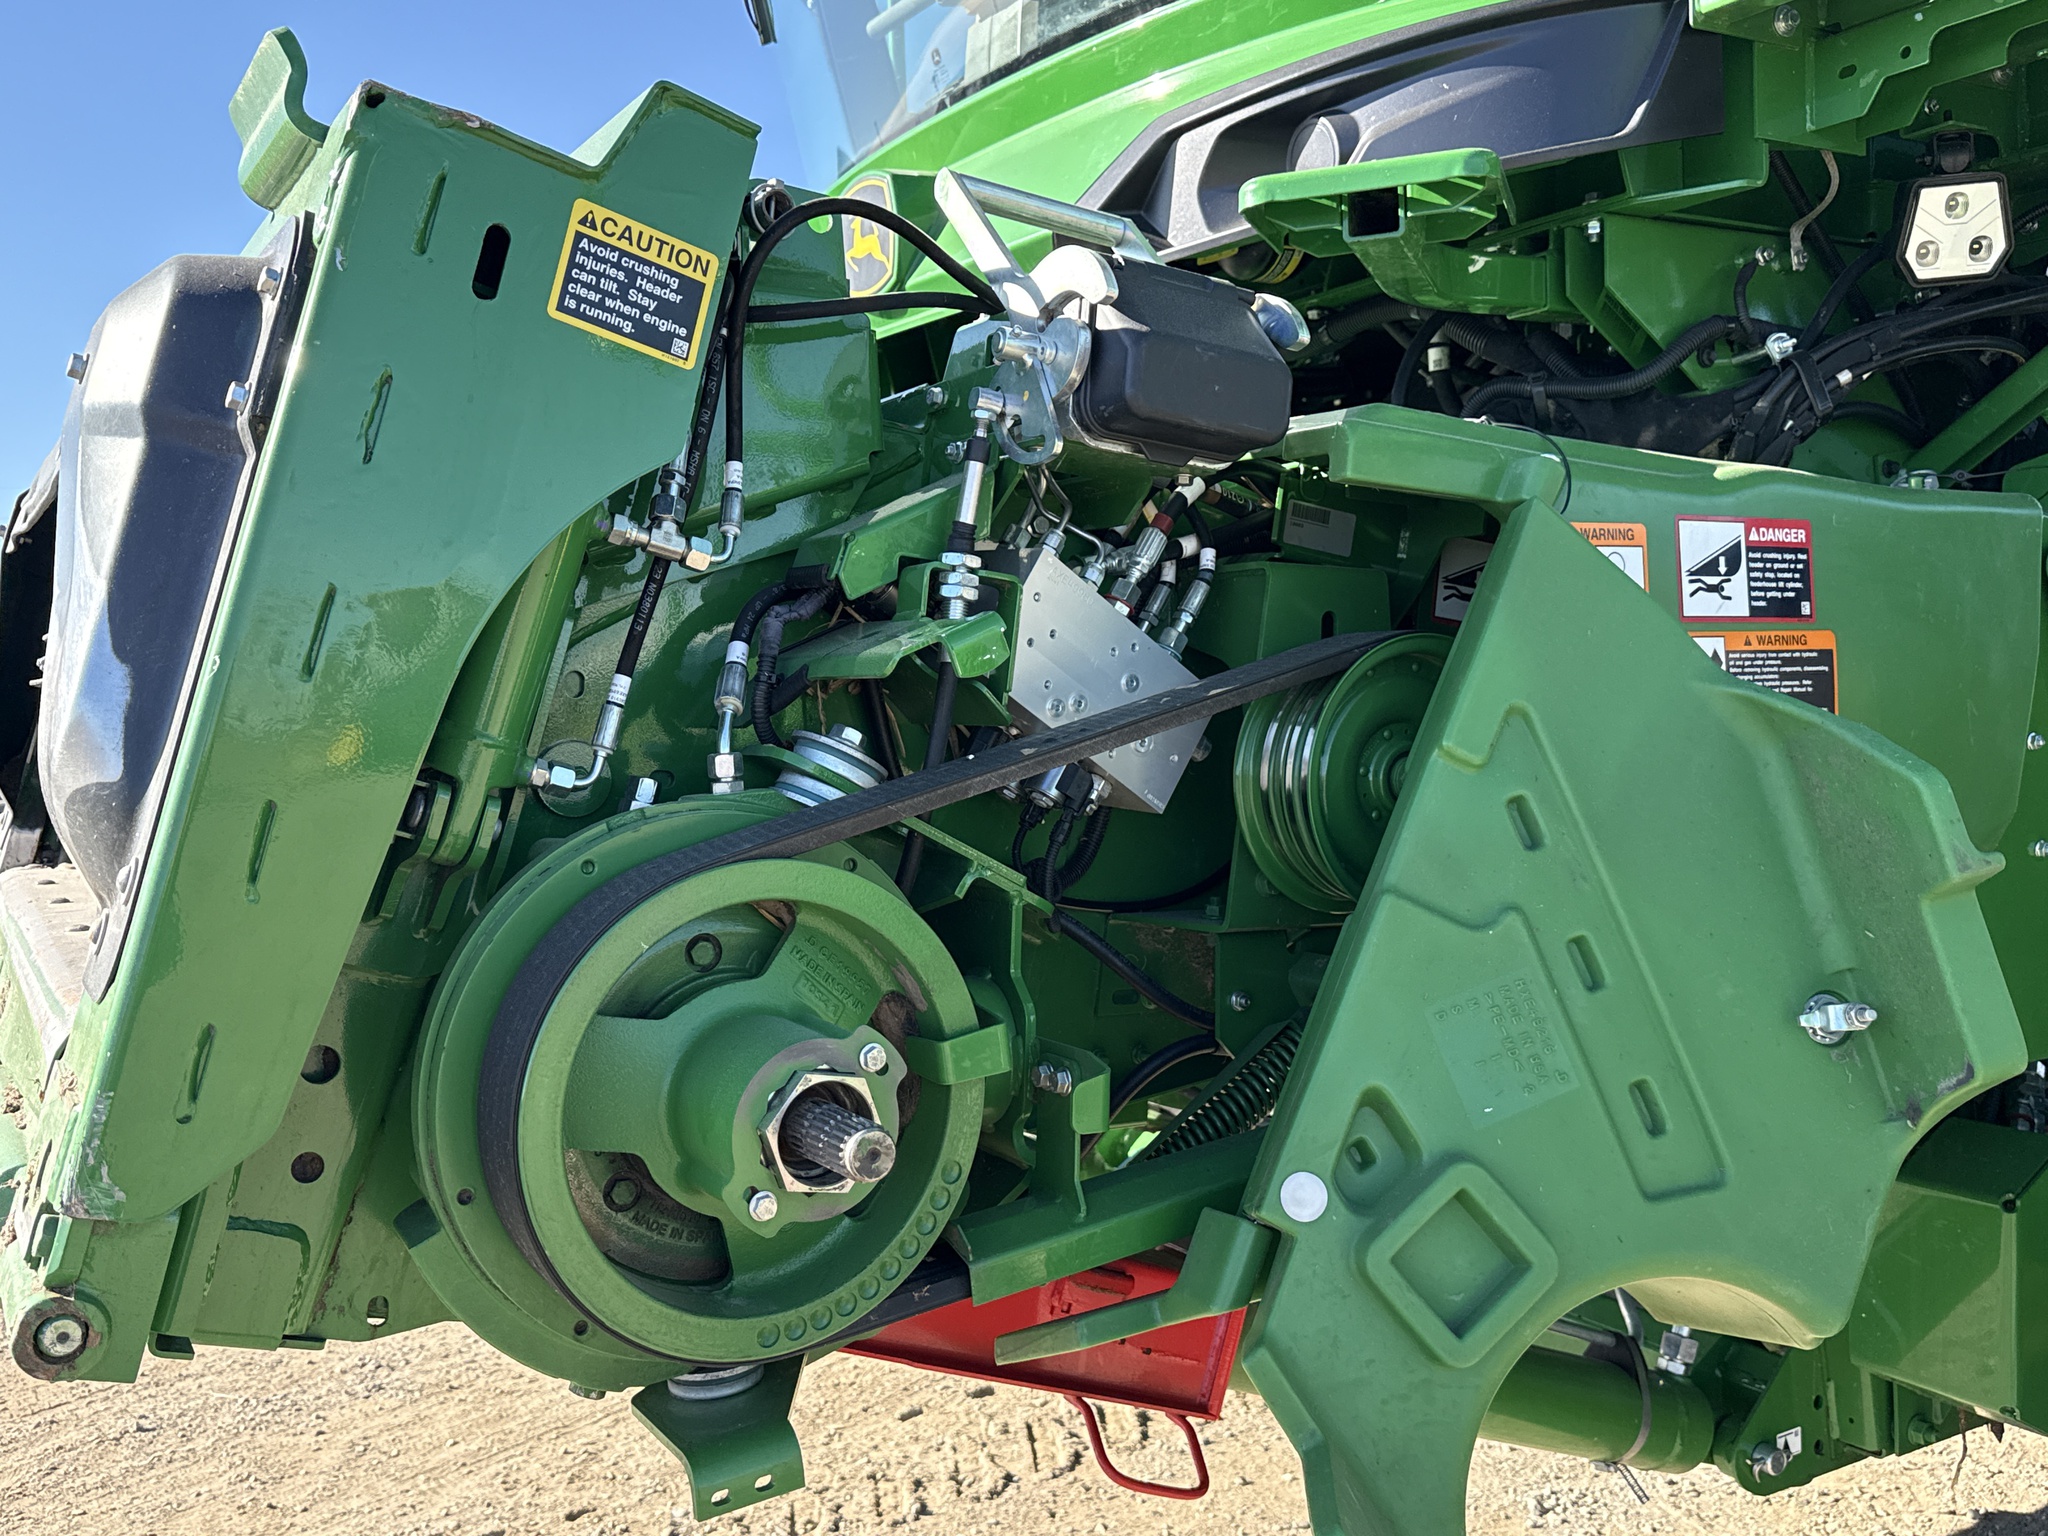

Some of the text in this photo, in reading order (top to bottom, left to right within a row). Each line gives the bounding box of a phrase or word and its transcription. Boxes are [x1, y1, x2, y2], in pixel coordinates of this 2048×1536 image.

[578, 237, 680, 290] Avoid crushing
[600, 217, 711, 278] CAUTION
[571, 268, 658, 312] can tilt. Stay
[575, 251, 683, 304] injuries. Header
[564, 295, 635, 333] is running.
[567, 282, 688, 337] clear when engine
[1580, 527, 1635, 541] WARNING
[1759, 527, 1806, 544] DANGER
[1748, 551, 1761, 559] Avoid
[1762, 552, 1782, 560] crushing
[1749, 571, 1763, 579] safety
[1766, 590, 1782, 598] getting
[1756, 634, 1808, 646] WARNING
[790, 945, 824, 977] MADE
[822, 971, 836, 988] IN
[833, 984, 866, 1015] SPAIN
[1499, 984, 1524, 1025] MADE
[1519, 1031, 1535, 1049] IN
[631, 1210, 668, 1237] MADE
[669, 1226, 685, 1241] IN
